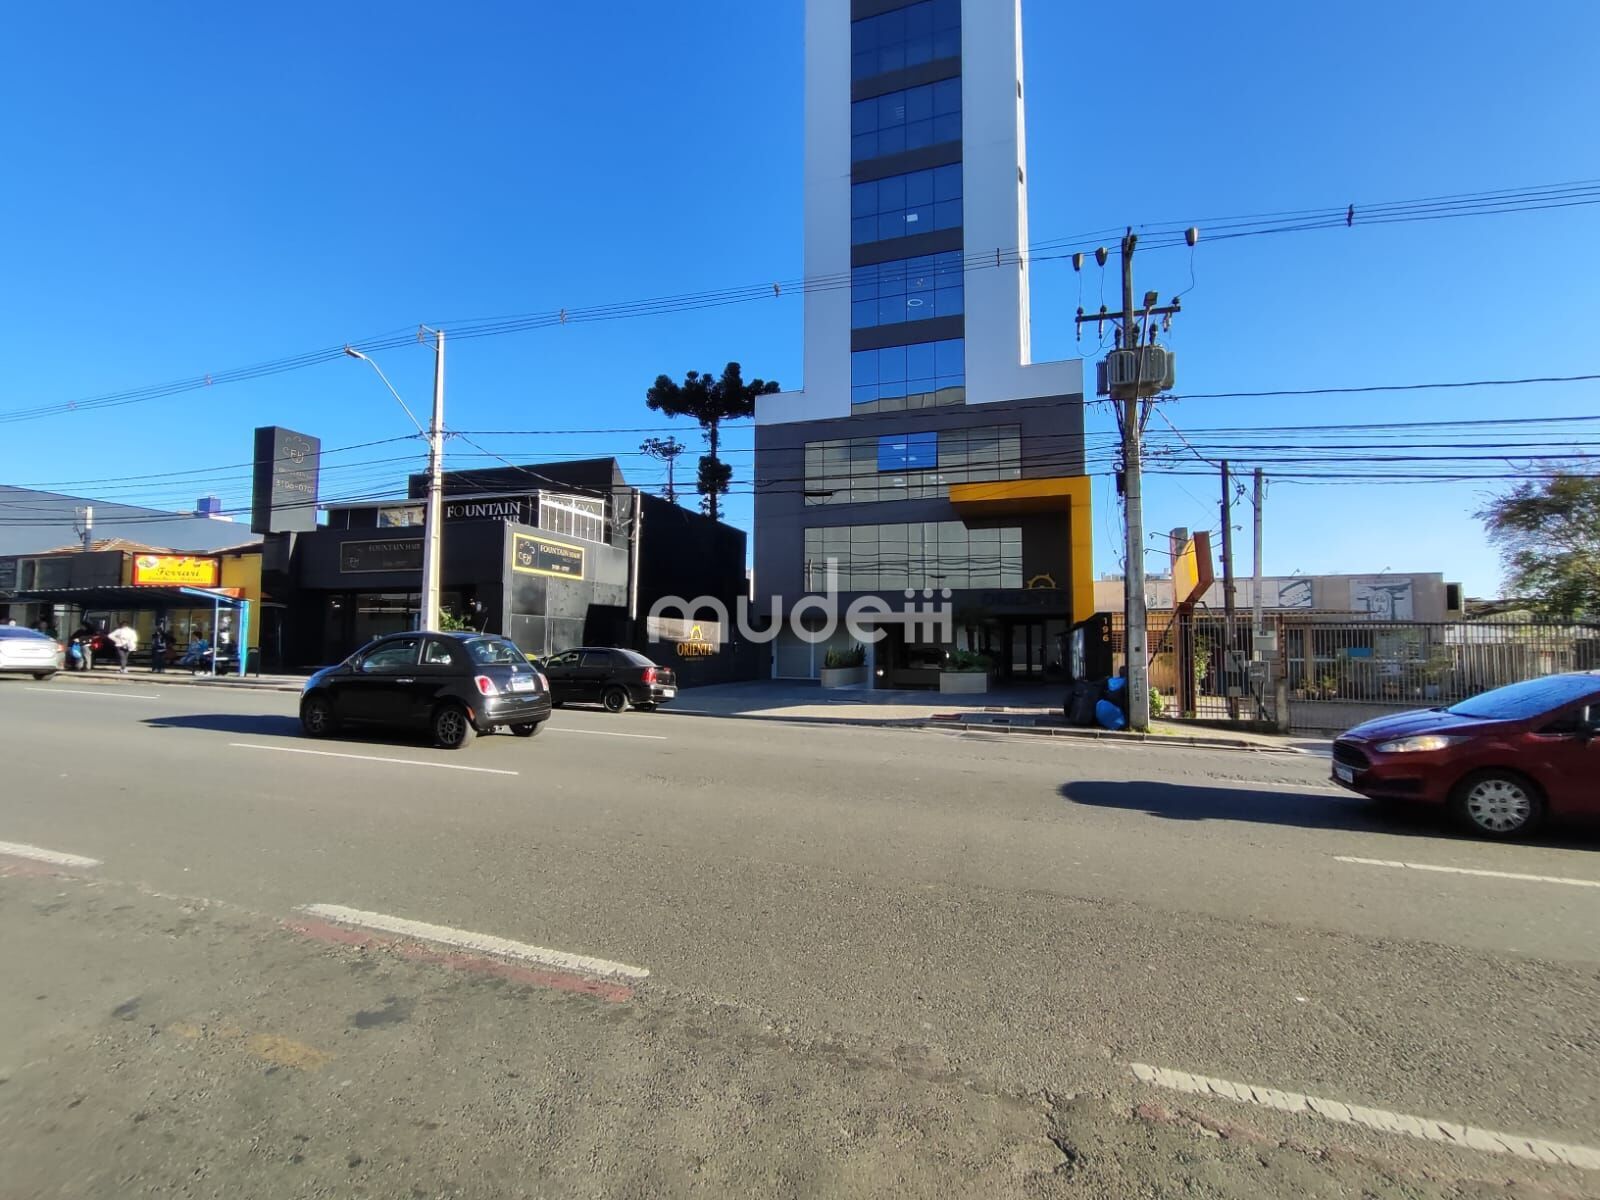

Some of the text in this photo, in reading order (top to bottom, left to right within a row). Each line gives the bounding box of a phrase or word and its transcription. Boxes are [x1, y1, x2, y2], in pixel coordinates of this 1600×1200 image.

[447, 502, 520, 518] FOUNTAIN
[539, 544, 568, 558] FOUNTAIN
[156, 566, 200, 577] Ferrari
[676, 642, 713, 656] ORIENTE
